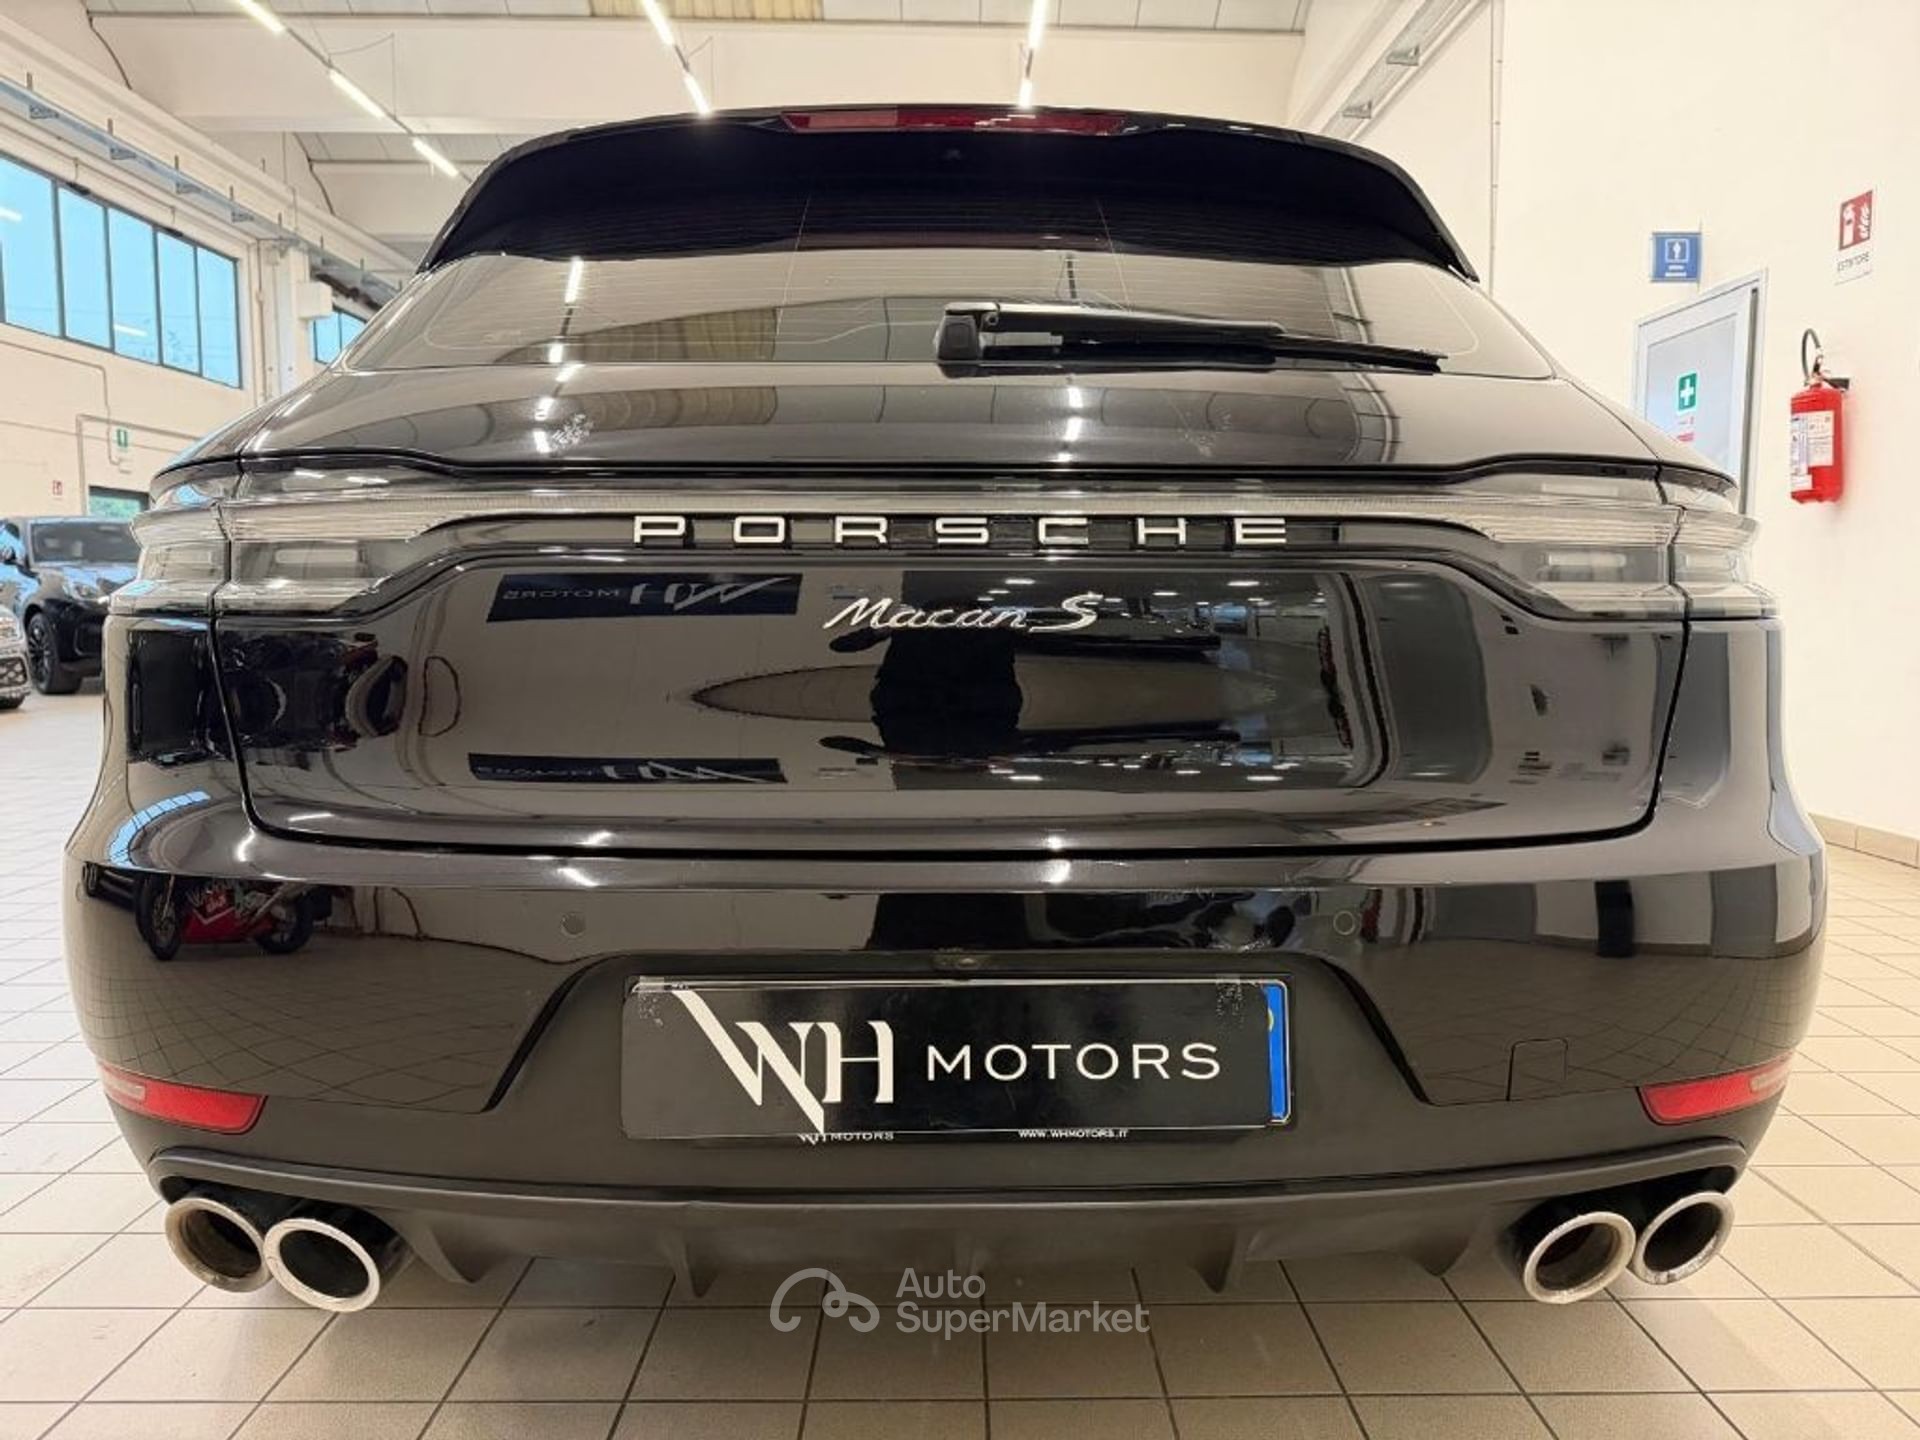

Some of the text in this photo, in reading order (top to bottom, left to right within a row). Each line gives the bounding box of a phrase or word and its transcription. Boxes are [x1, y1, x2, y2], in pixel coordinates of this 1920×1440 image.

[634, 516, 1287, 545] PORSCHE
[822, 591, 1104, 633] Macan S
[672, 989, 1221, 1134] WH MOTORS
[830, 1131, 895, 1141] MOTORS
